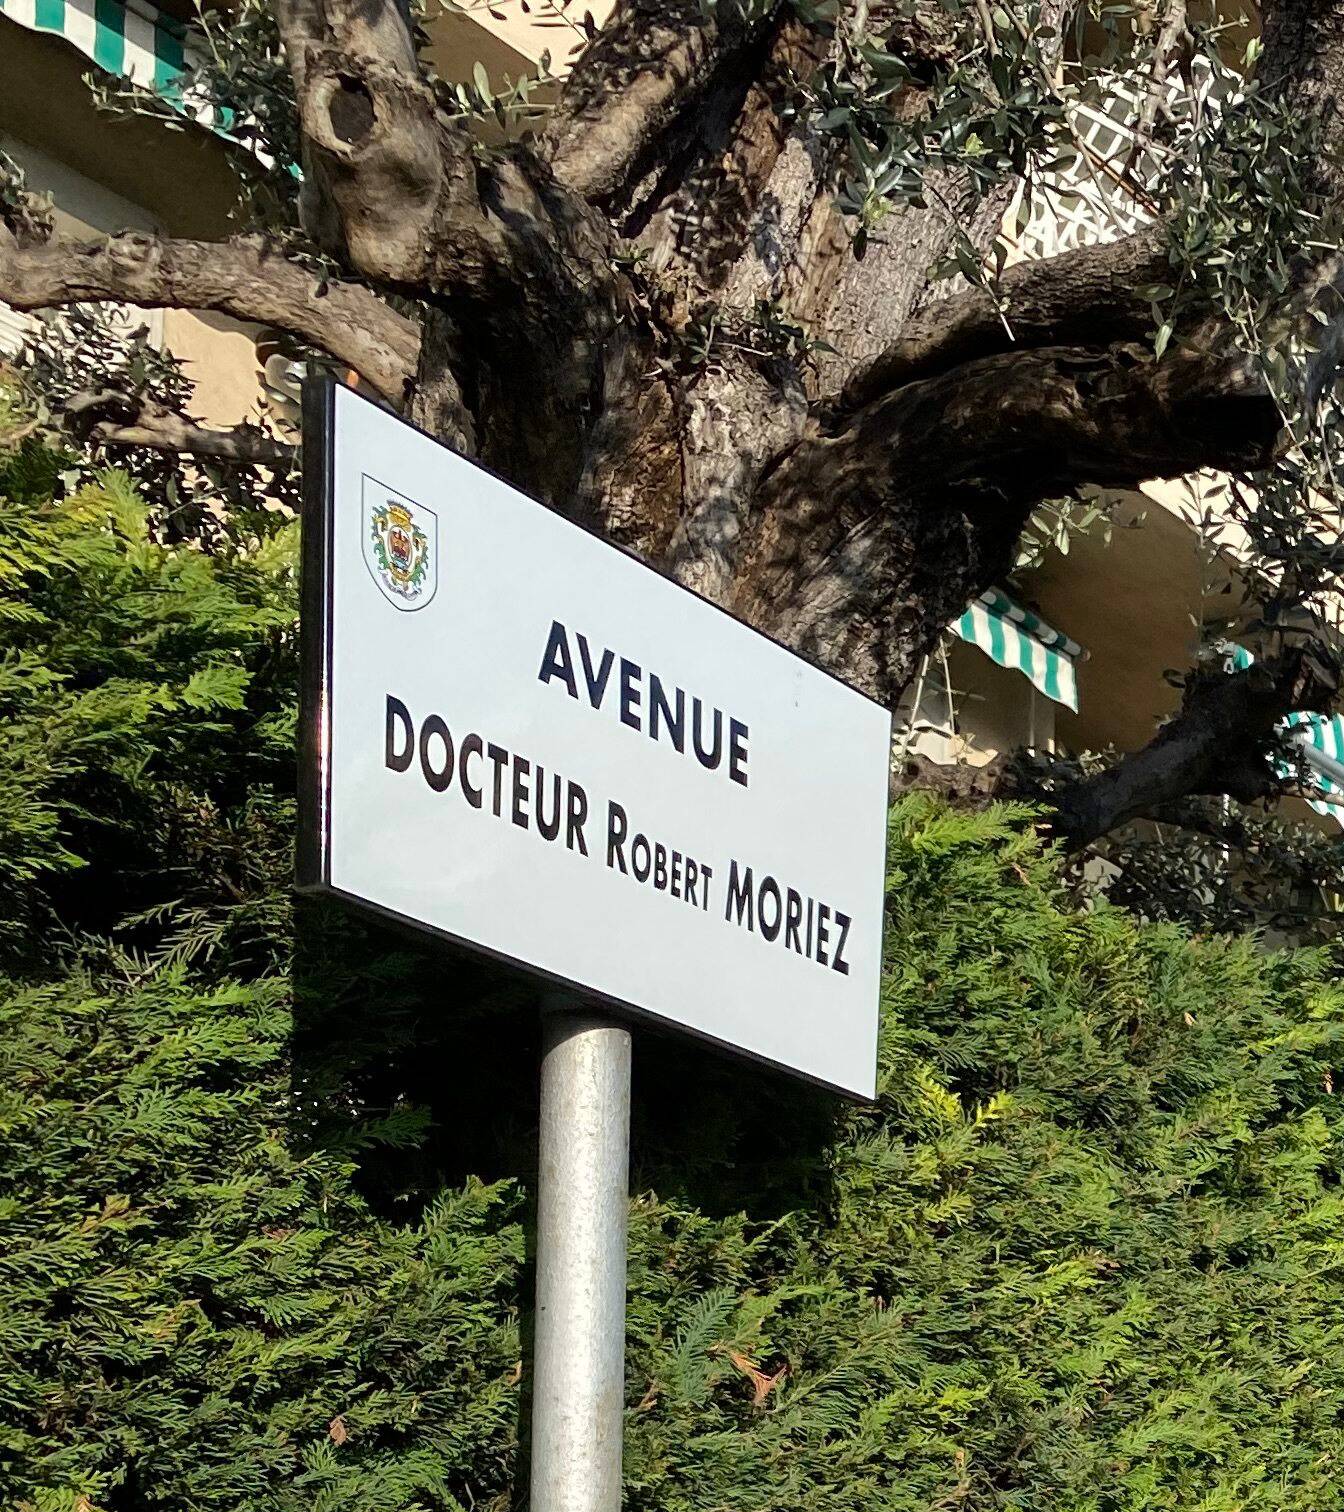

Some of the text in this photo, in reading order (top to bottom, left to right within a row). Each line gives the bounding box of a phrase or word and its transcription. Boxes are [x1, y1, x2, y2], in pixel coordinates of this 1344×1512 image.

[537, 619, 750, 788] AVENUE
[385, 693, 589, 858] DOCTEUR
[725, 859, 852, 976] MORIEZ
